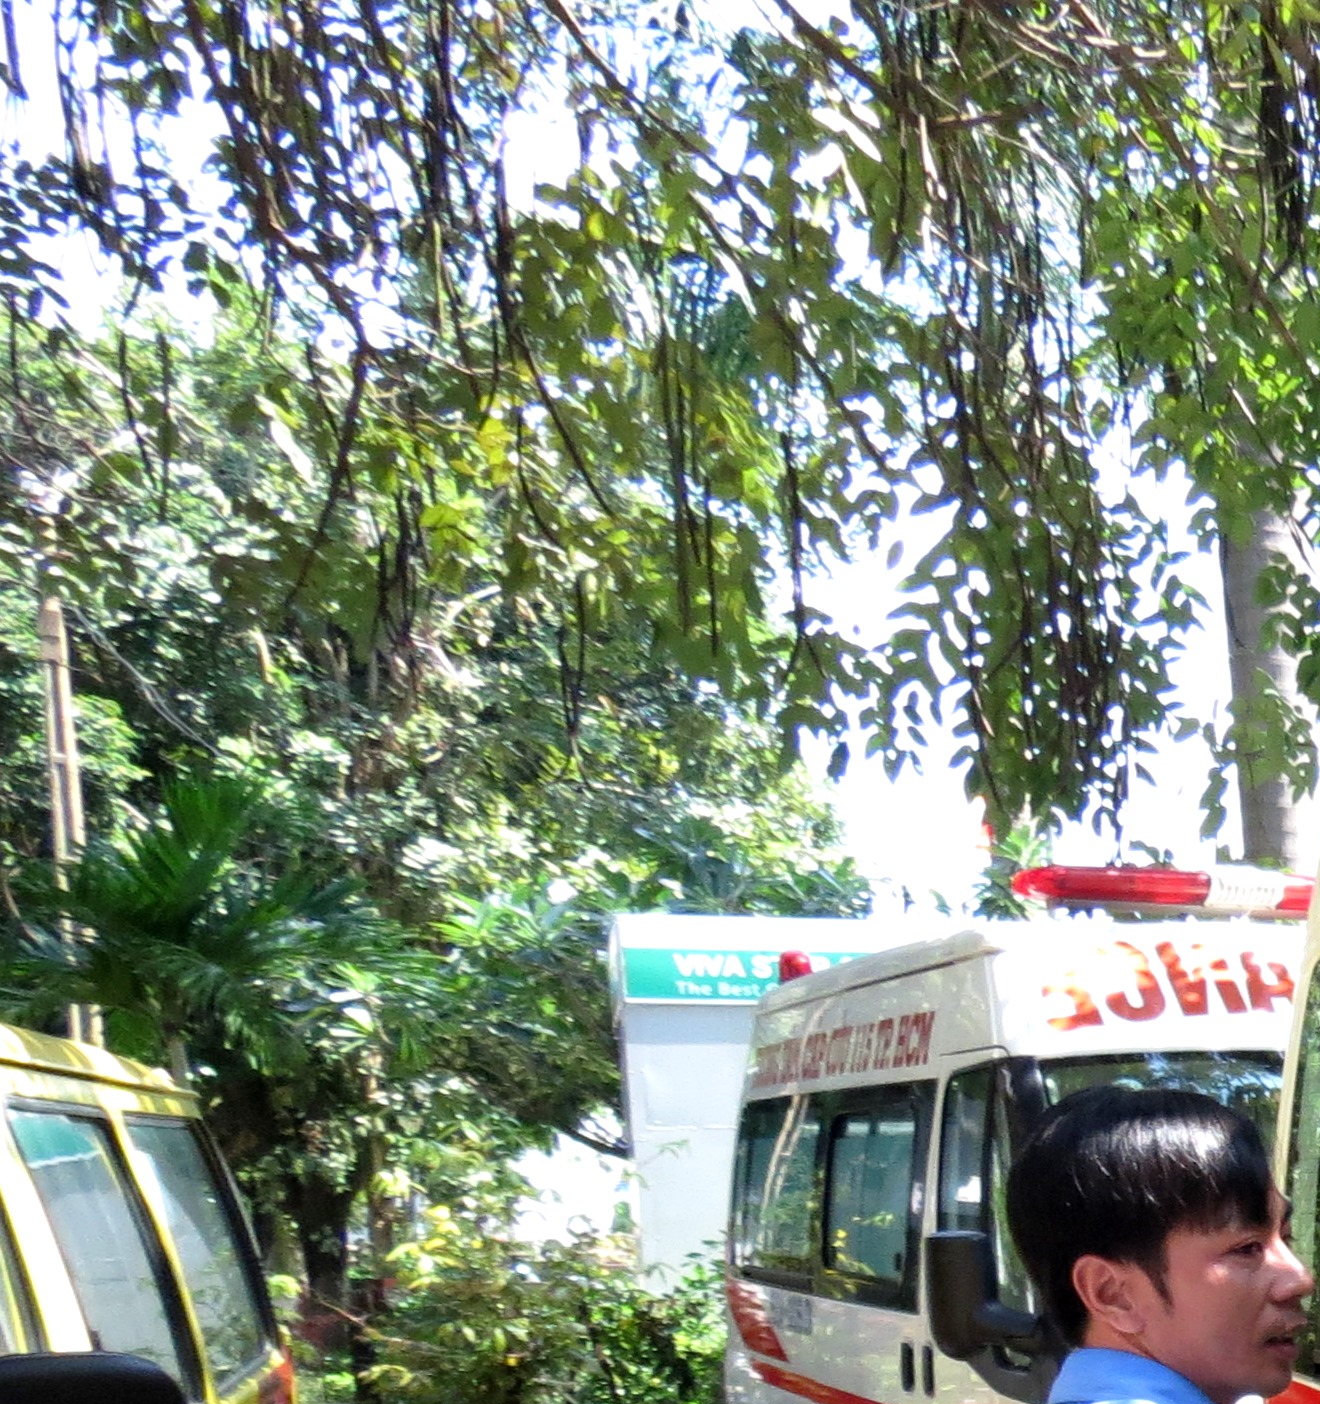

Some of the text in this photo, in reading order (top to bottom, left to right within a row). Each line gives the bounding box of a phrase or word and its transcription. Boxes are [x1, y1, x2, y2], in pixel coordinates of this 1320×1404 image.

[673, 952, 747, 978] VIVA
[675, 981, 714, 997] The
[717, 981, 759, 997] Best
